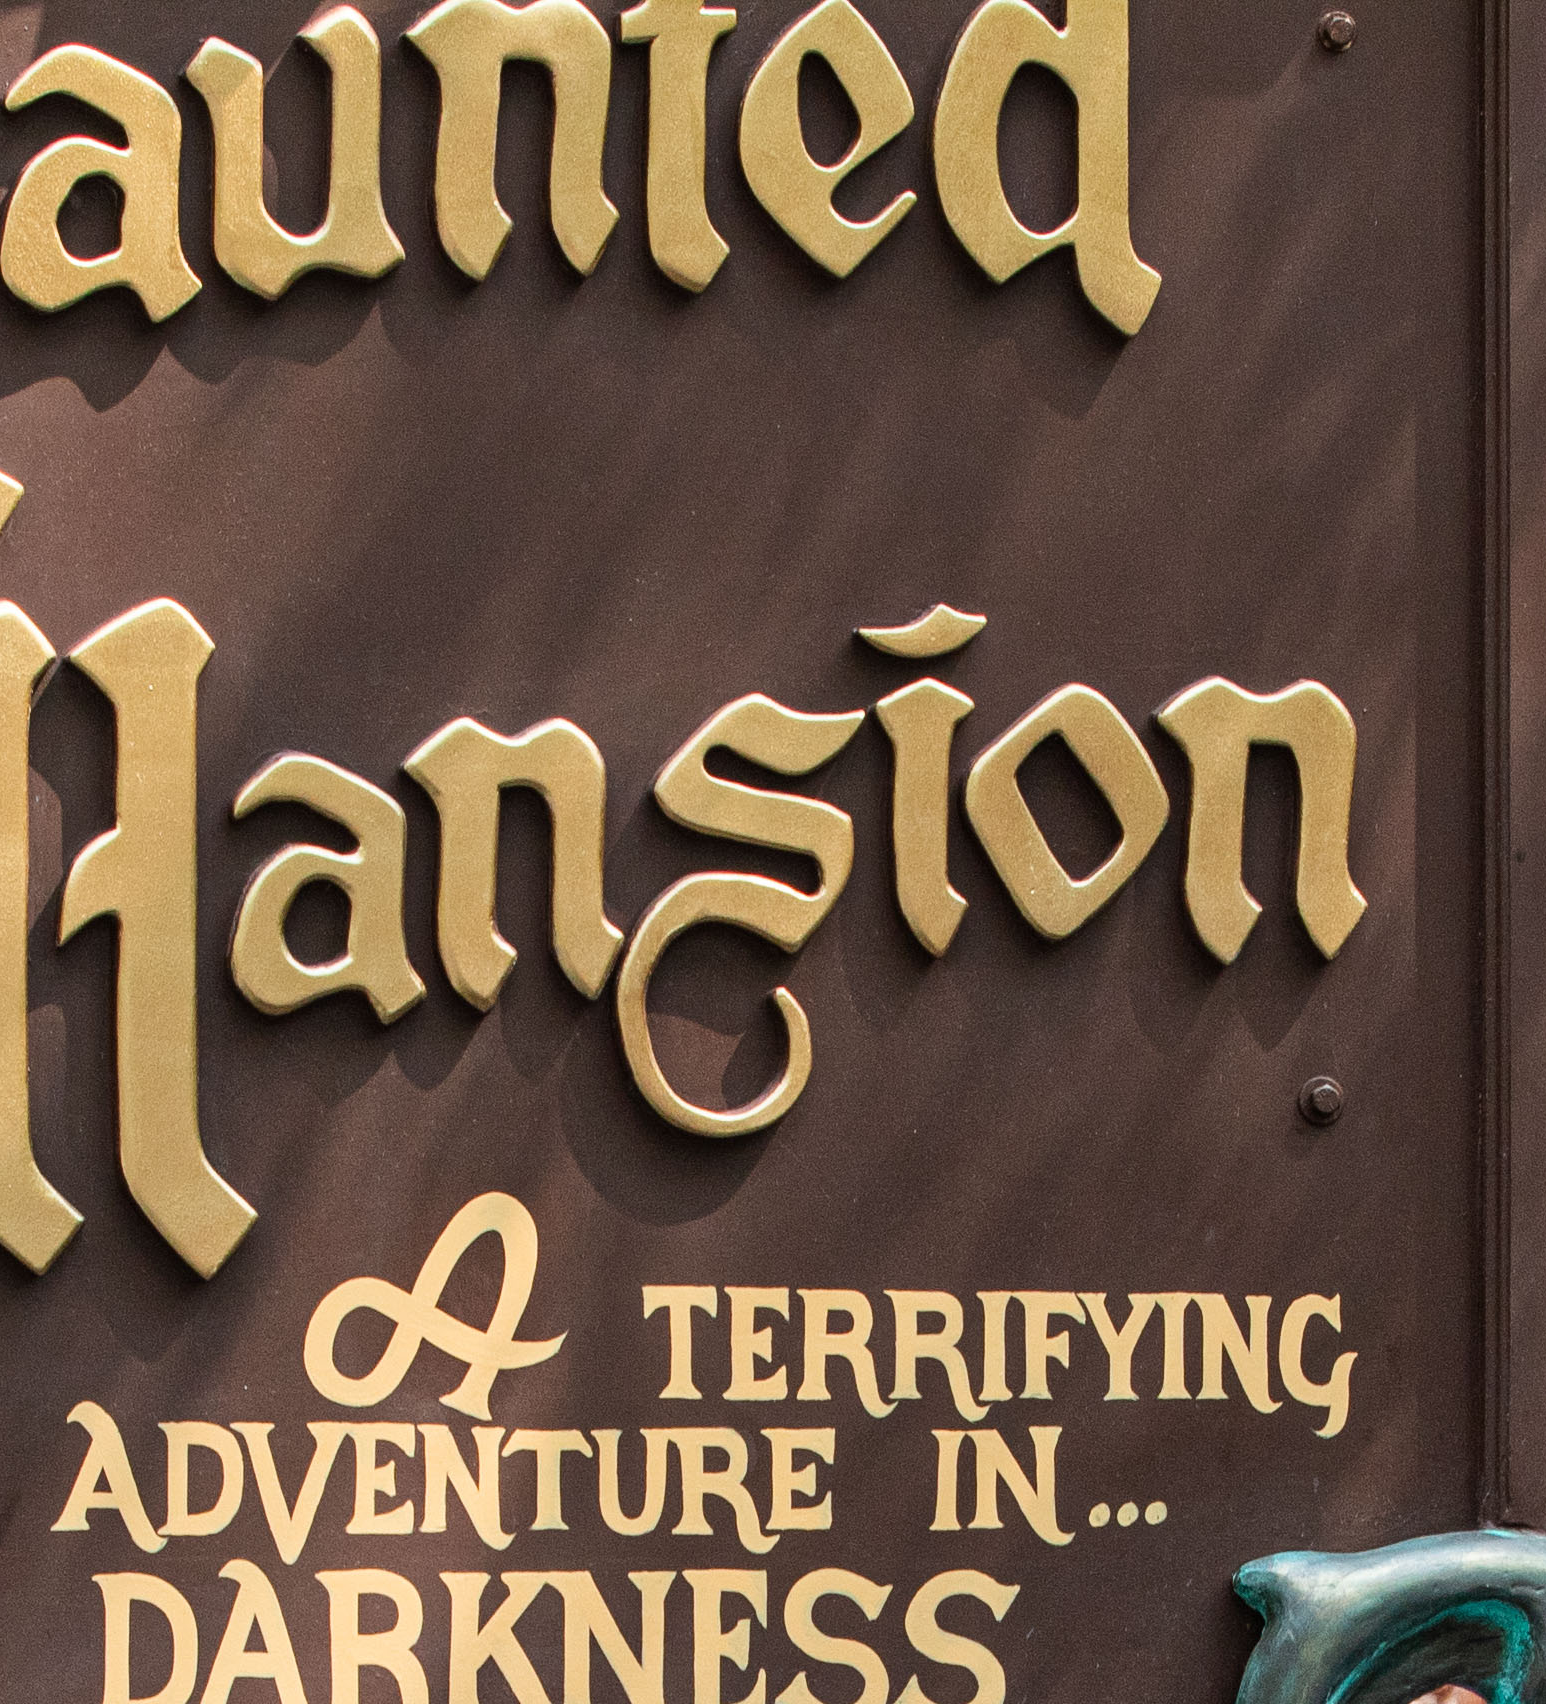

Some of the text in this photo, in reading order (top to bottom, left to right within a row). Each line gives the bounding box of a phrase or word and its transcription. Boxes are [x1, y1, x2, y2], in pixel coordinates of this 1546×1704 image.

[302, 1190, 1360, 1440] A TERRIFYING
[50, 1401, 837, 1564] ADVENTURE
